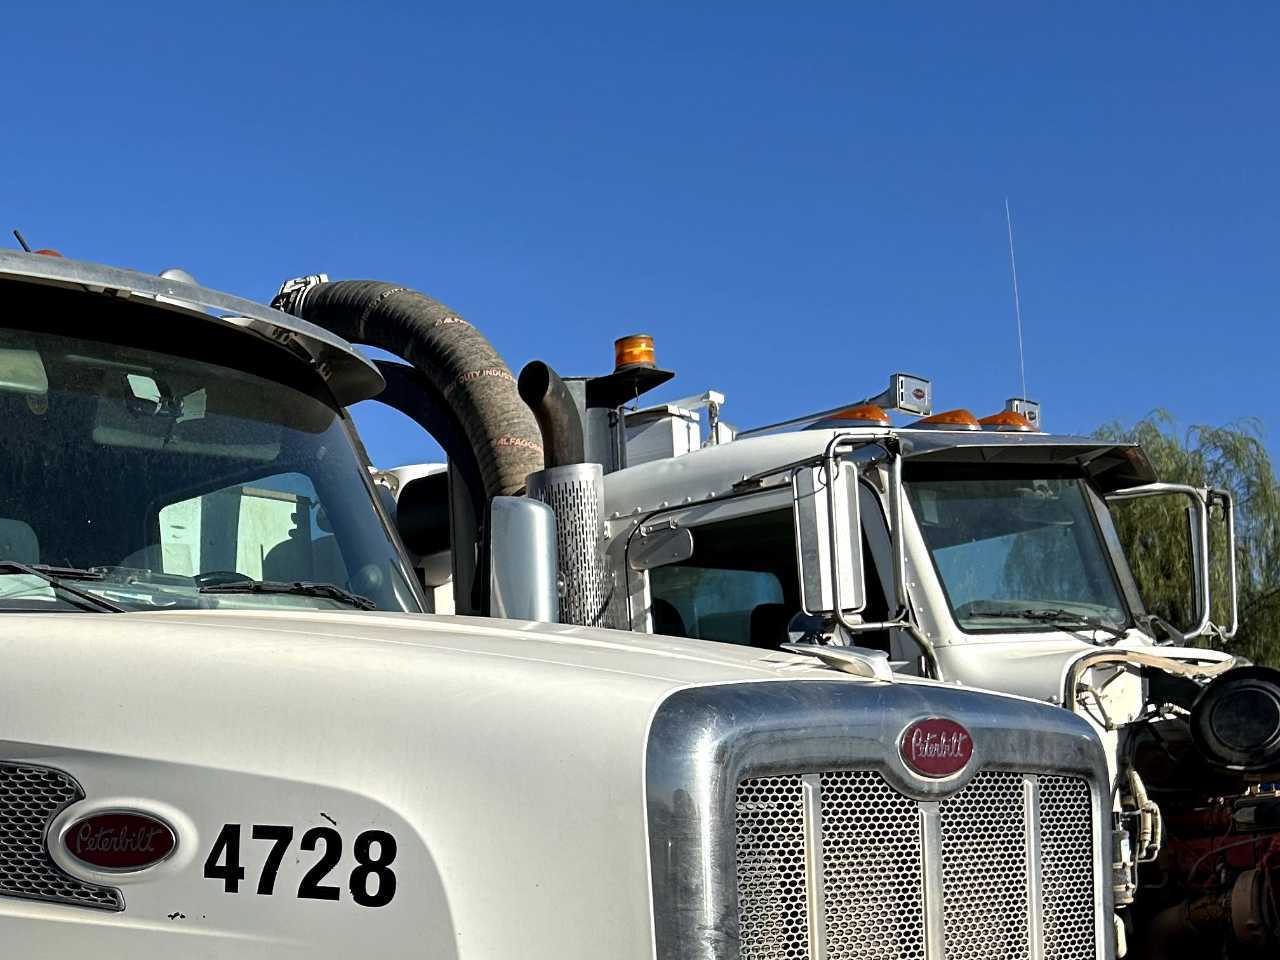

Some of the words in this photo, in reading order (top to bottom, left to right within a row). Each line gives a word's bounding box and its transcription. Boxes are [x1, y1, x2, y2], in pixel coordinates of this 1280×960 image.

[912, 728, 967, 760] Peterbilt
[76, 822, 163, 854] Peterbilt
[204, 823, 397, 908] 4728
